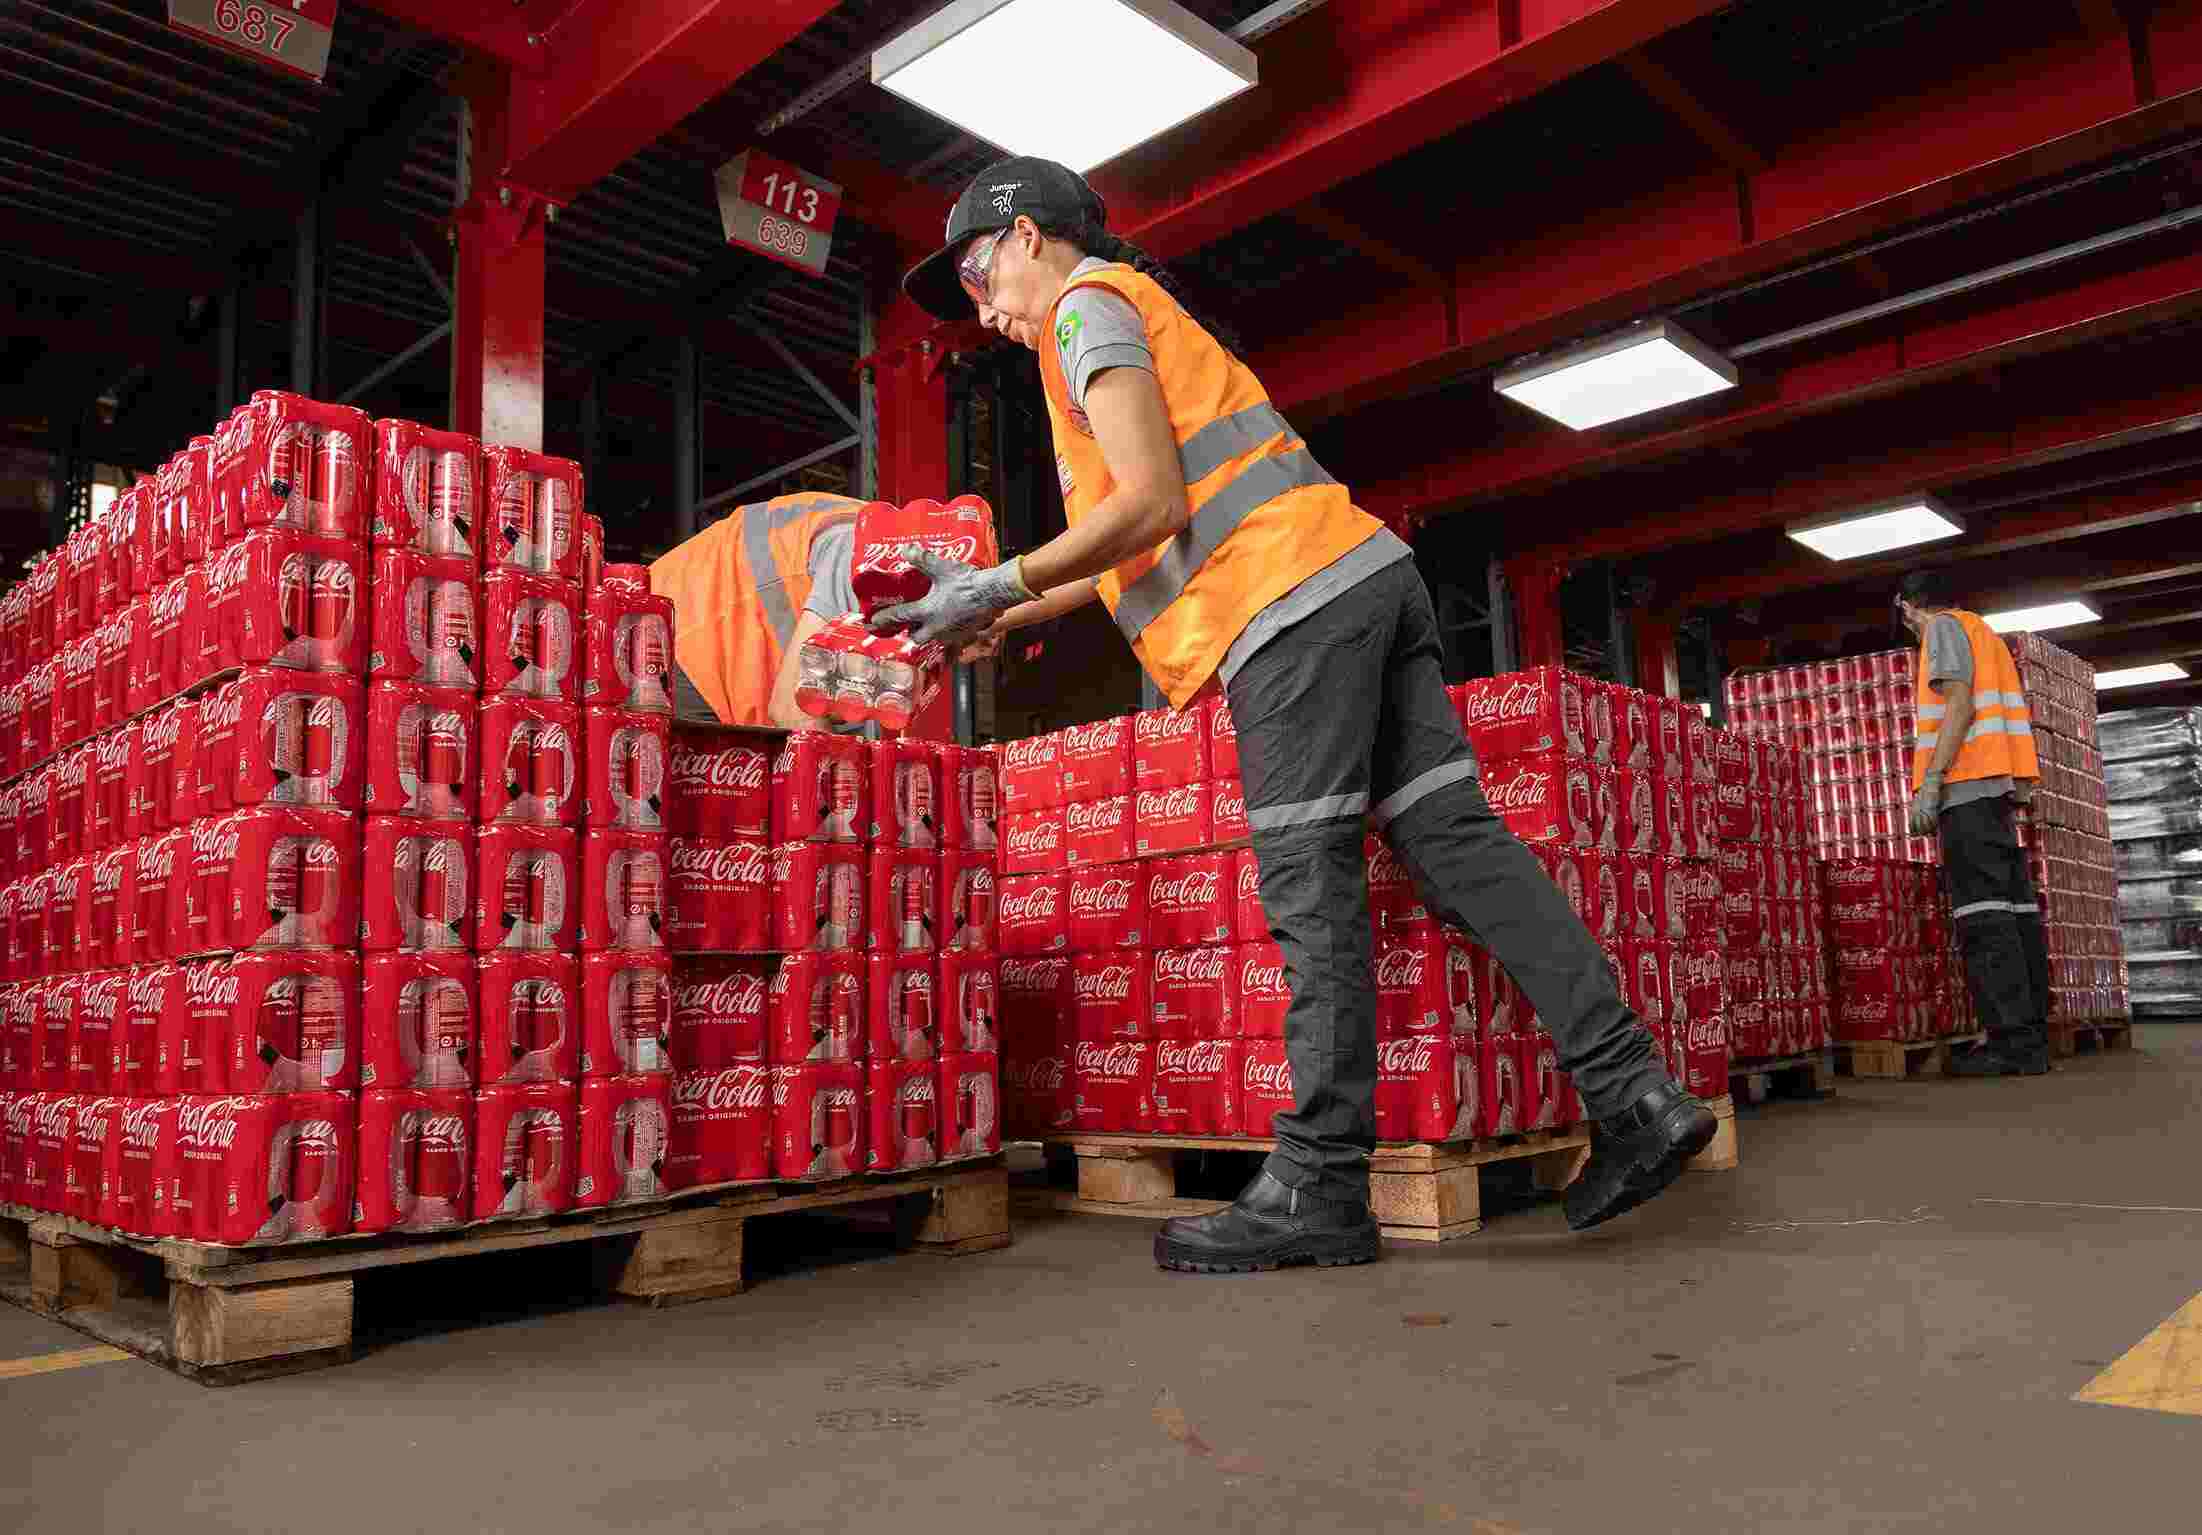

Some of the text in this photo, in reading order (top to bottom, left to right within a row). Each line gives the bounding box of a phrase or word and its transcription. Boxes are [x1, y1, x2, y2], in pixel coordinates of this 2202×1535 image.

[214, 0, 297, 51] 687
[763, 172, 819, 223] 113
[758, 215, 808, 257] 639
[1467, 681, 1545, 727] Coca-Cola
[1136, 784, 1201, 824] Coca-Cola
[1000, 886, 1064, 924] Coca-Cola
[1069, 879, 1135, 913] Coca-Cola
[1149, 871, 1218, 908] Coca-Cola
[1154, 945, 1233, 982] Coca-Cola
[1074, 1040, 1146, 1075] Coca-Cola
[1156, 1038, 1233, 1077] Coca-Cola
